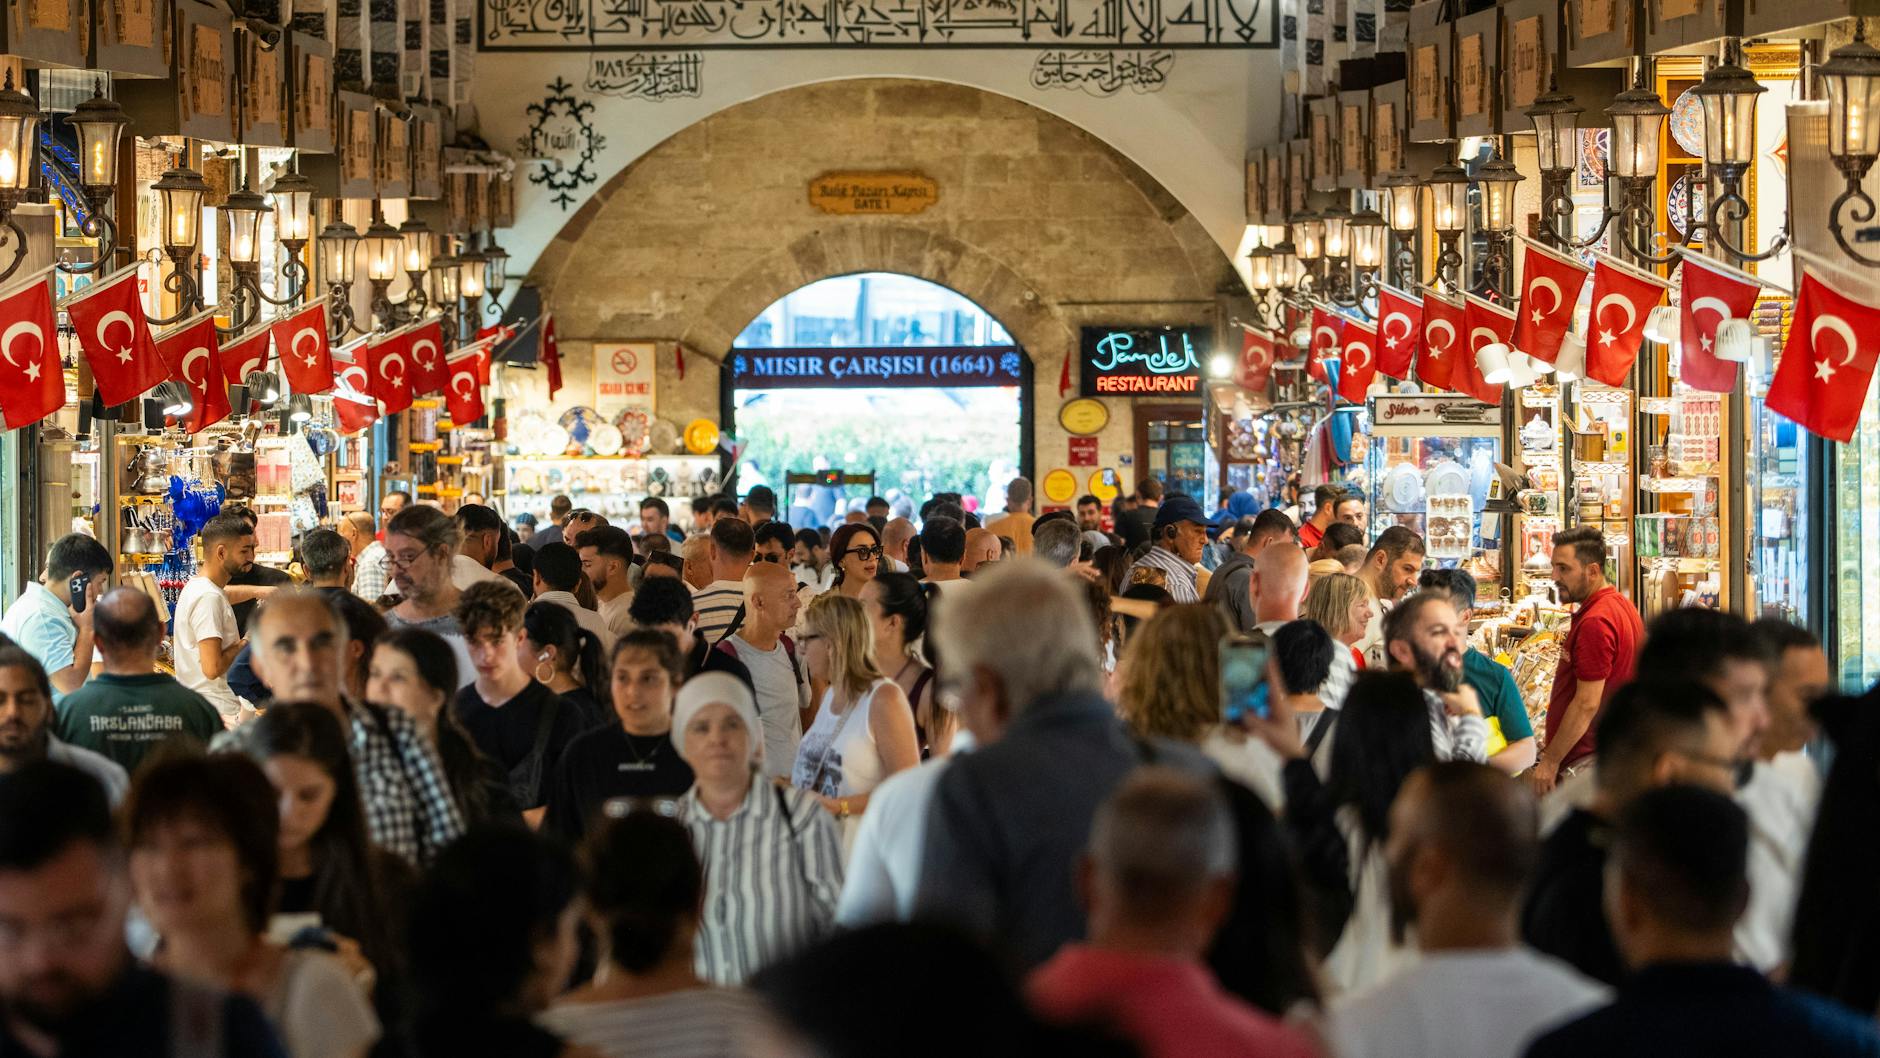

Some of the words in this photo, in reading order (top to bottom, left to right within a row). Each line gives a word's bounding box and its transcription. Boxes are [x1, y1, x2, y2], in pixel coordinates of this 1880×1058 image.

[854, 199, 883, 209] GATE
[1091, 332, 1200, 374] Pandeli
[752, 356, 825, 376] MISIR
[828, 355, 925, 380] ÇARŞISI
[929, 355, 996, 377] (1664)
[1096, 375, 1200, 392] RESTAURANT
[1384, 402, 1420, 420] Silver
